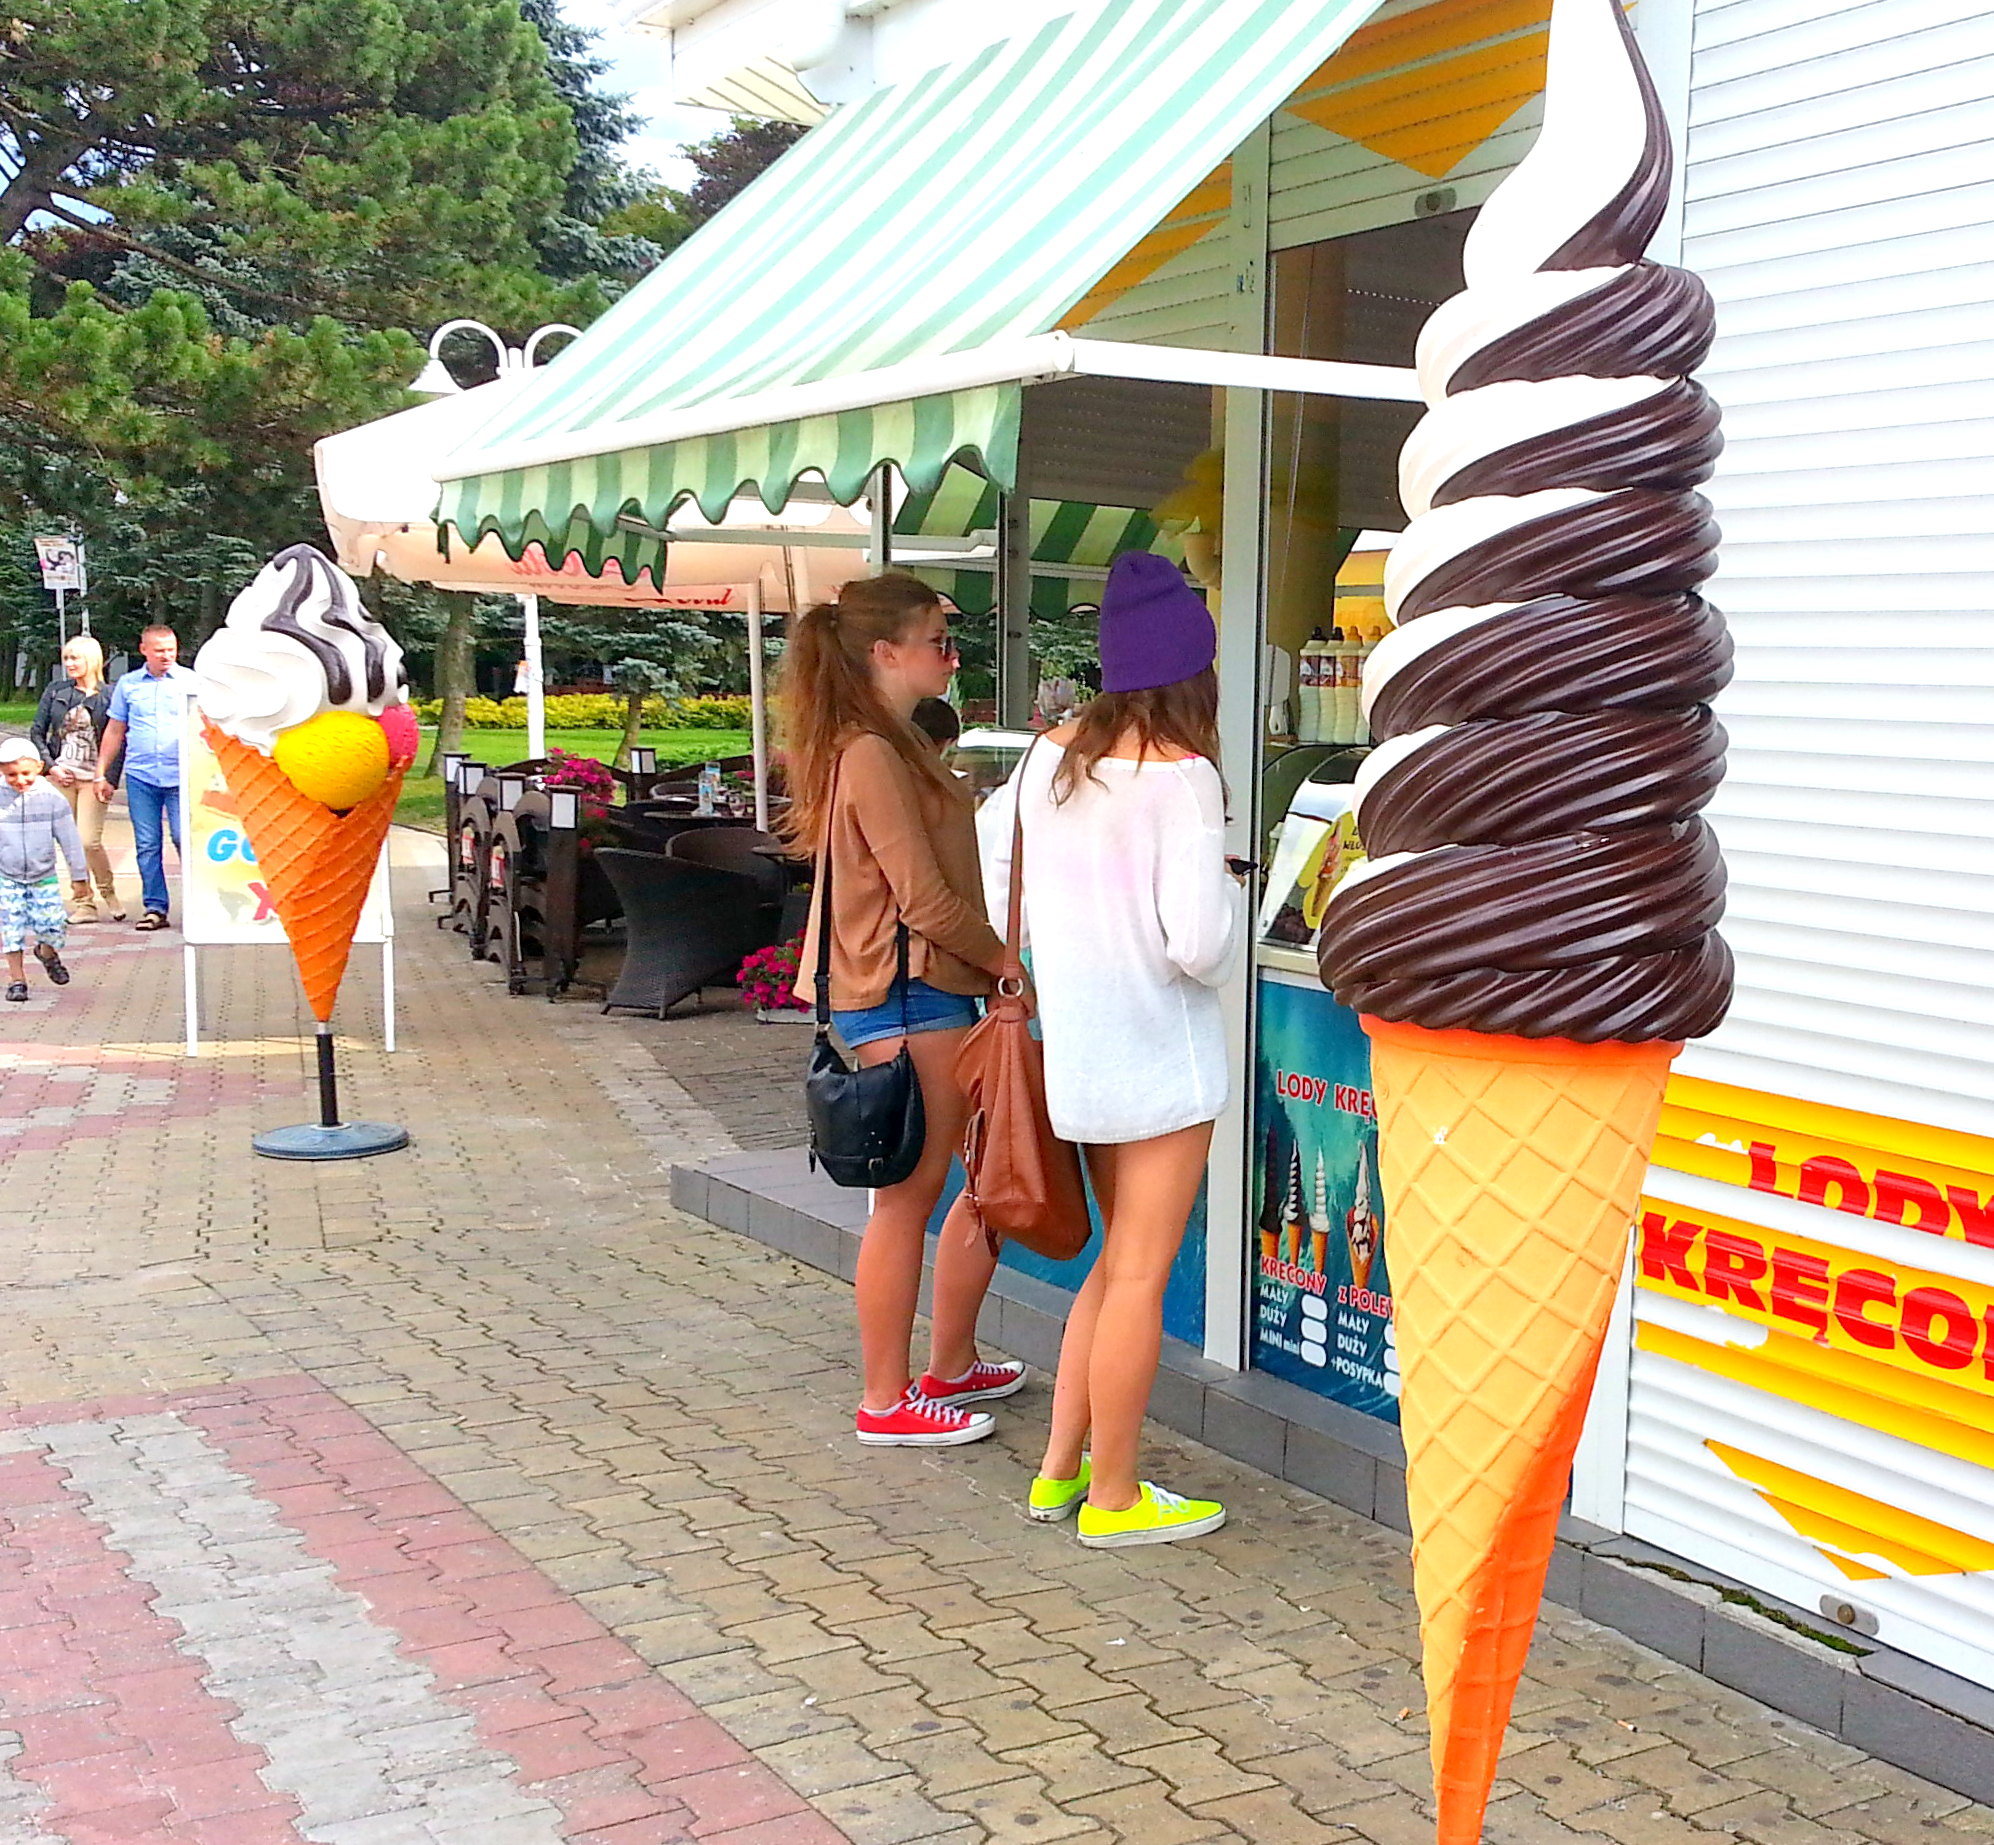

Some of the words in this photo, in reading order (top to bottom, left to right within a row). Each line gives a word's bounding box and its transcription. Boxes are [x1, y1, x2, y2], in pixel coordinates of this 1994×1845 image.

[1277, 1069, 1327, 1106] LODY
[1748, 1140, 1994, 1250] LODY
[1640, 1211, 1994, 1384] KRĘCO
[1260, 1304, 1287, 1328] DUŻY
[1260, 1327, 1282, 1348] MINI
[1337, 1332, 1368, 1358] DUŻY
